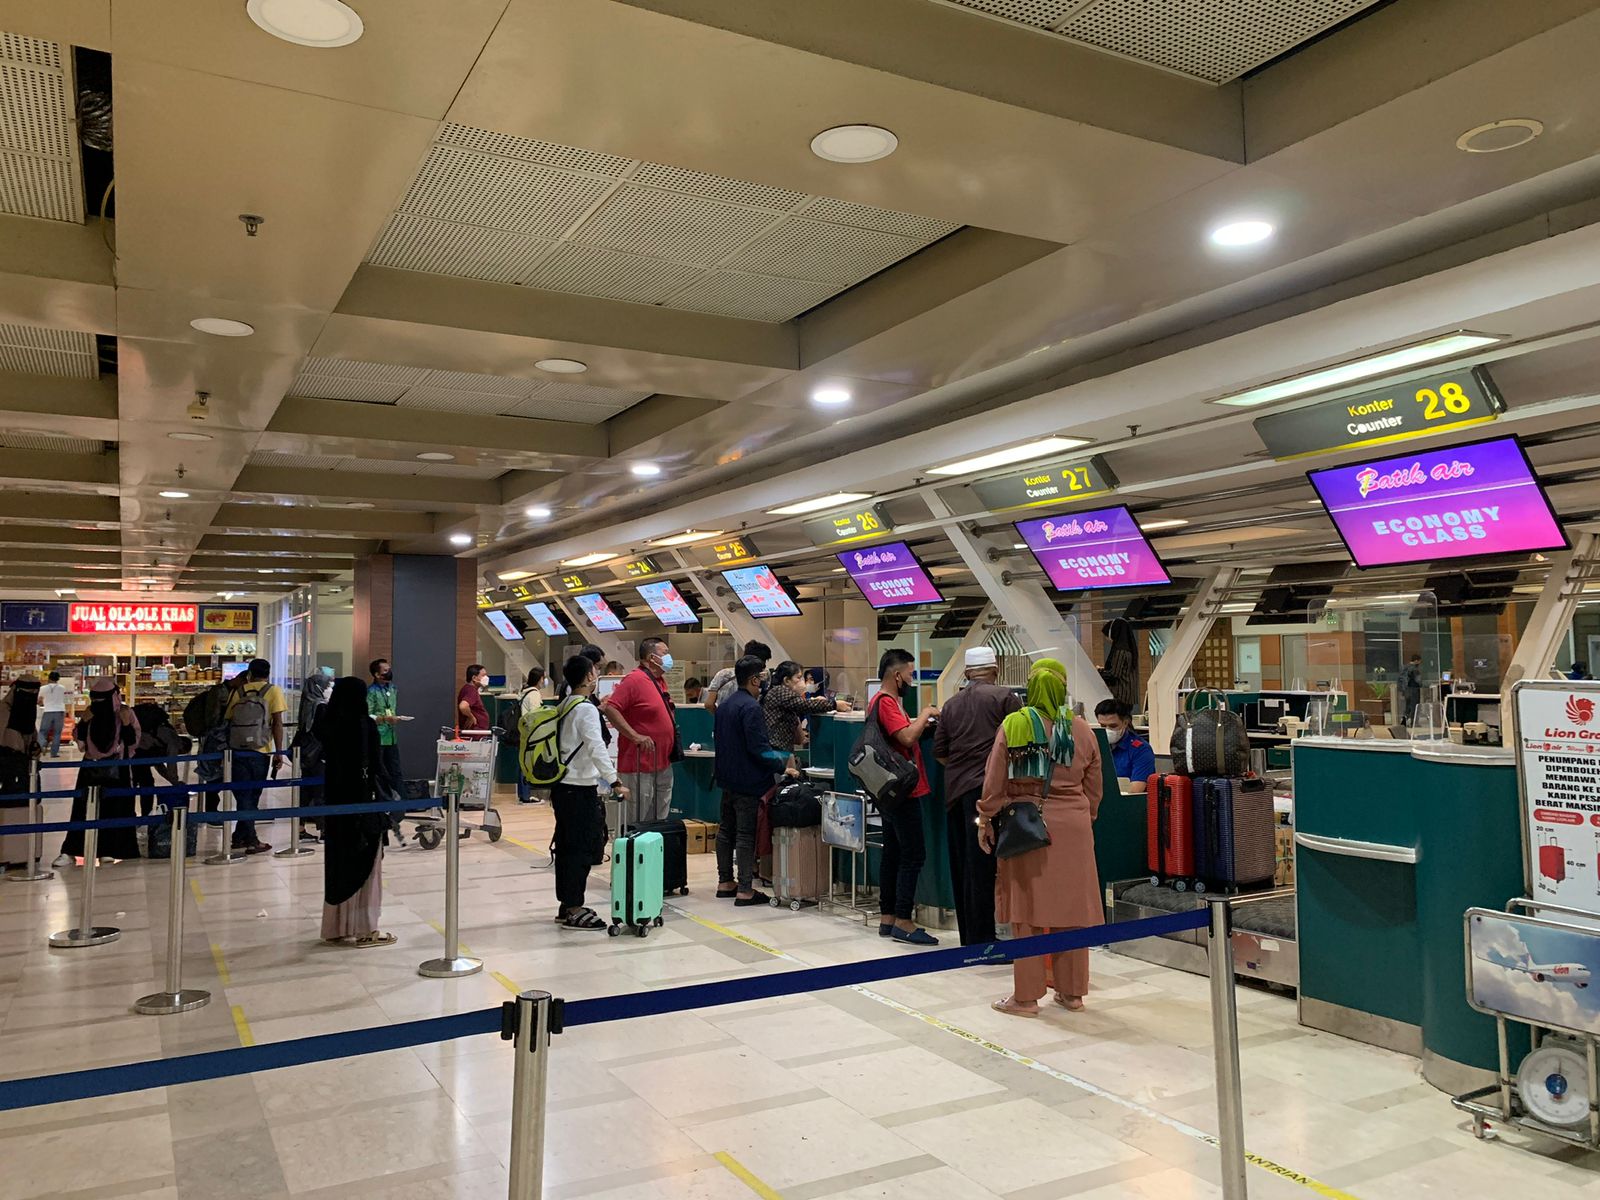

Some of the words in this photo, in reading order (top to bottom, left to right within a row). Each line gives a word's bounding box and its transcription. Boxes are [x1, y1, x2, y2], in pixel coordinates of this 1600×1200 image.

[1347, 399, 1393, 417] Konter
[1415, 382, 1470, 420] 28
[1347, 415, 1403, 435] Counter
[1024, 475, 1051, 486] Konter
[1061, 466, 1092, 490] 27
[1356, 461, 1427, 498] Batik
[1430, 460, 1475, 480] air
[1026, 486, 1059, 497] Counter
[856, 511, 879, 531] 26
[1372, 506, 1500, 535] ECONOMY
[1042, 519, 1082, 543] Batik
[1083, 519, 1108, 533] air
[1402, 524, 1487, 546] CLASS
[729, 542, 746, 557] 25
[1058, 552, 1130, 569] ECONOMY
[1077, 564, 1125, 578] CLASS
[869, 577, 915, 591] ECONOMY
[882, 586, 914, 598] CLASS
[72, 606, 106, 621] JUAL
[108, 606, 159, 622] OLE-OLE
[161, 606, 195, 622] KHAS
[95, 622, 173, 631] MAKASSAR
[1544, 728, 1576, 739] Lion
[1538, 755, 1596, 766] PENUMPANG
[1545, 774, 1596, 784] MEMBAWA
[1542, 782, 1580, 791] BARANG
[1583, 785, 1594, 793] KE
[1535, 799, 1564, 808] BERAT
[1547, 791, 1576, 801] KABIN
[1245, 1153, 1309, 1184] ANTRIAN
